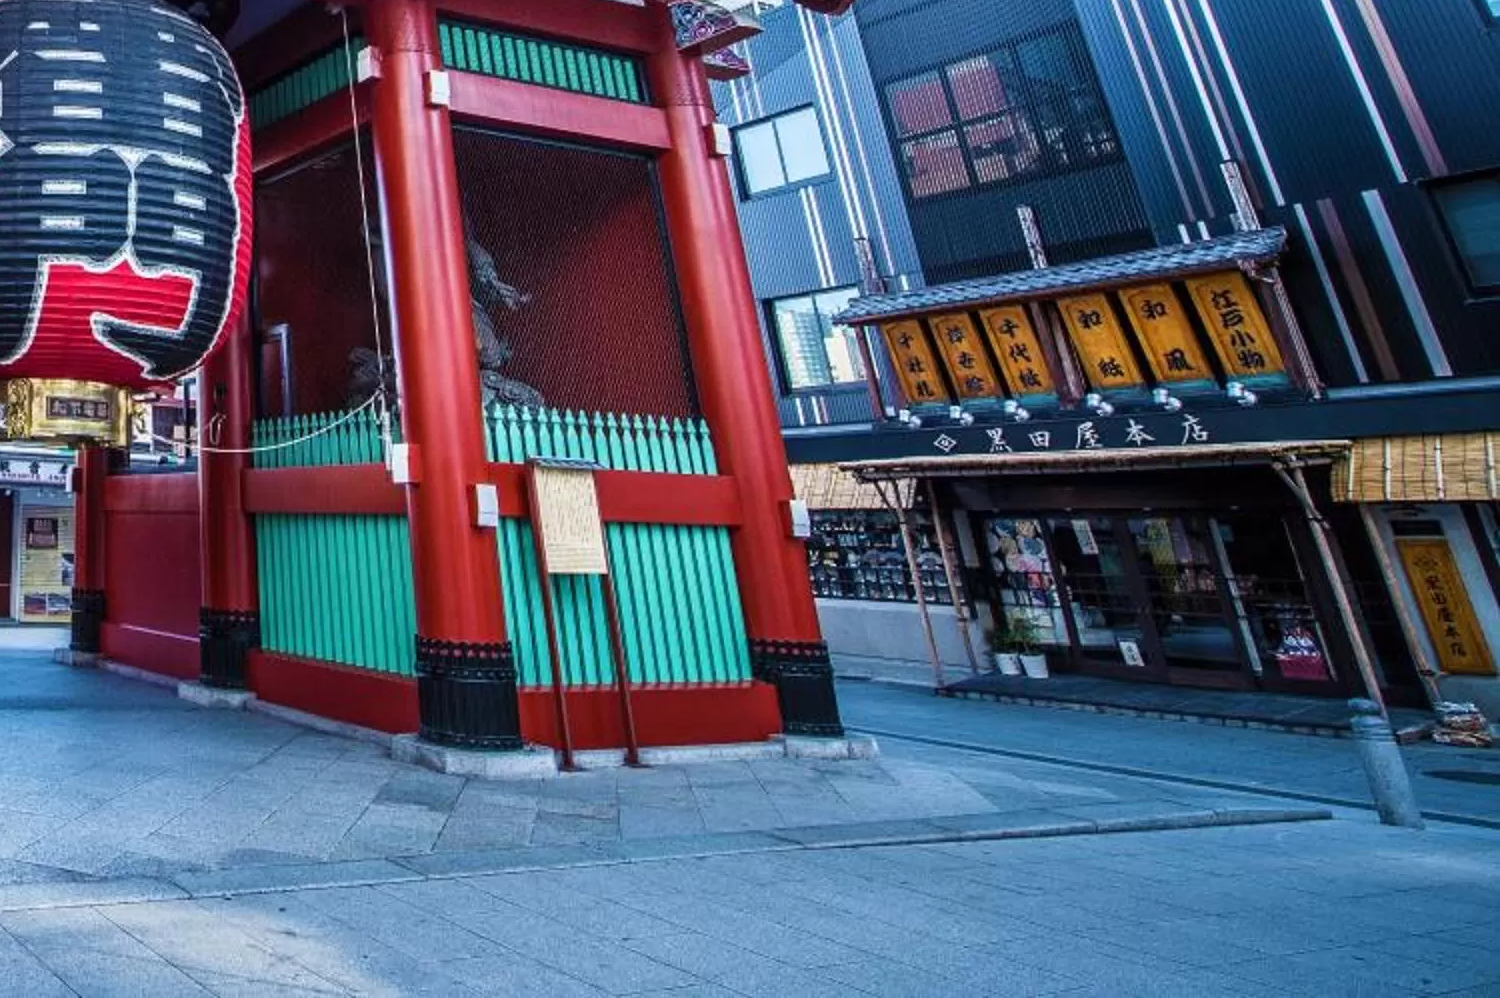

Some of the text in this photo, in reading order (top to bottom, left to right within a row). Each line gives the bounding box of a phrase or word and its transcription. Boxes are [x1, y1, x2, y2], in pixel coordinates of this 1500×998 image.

[1000, 319, 1042, 389] 千代紙
[1078, 309, 1127, 378] 和紙
[1140, 299, 1194, 373] 和風
[1211, 289, 1266, 372] 江戸小物
[985, 414, 1210, 453] 黒田屋本店
